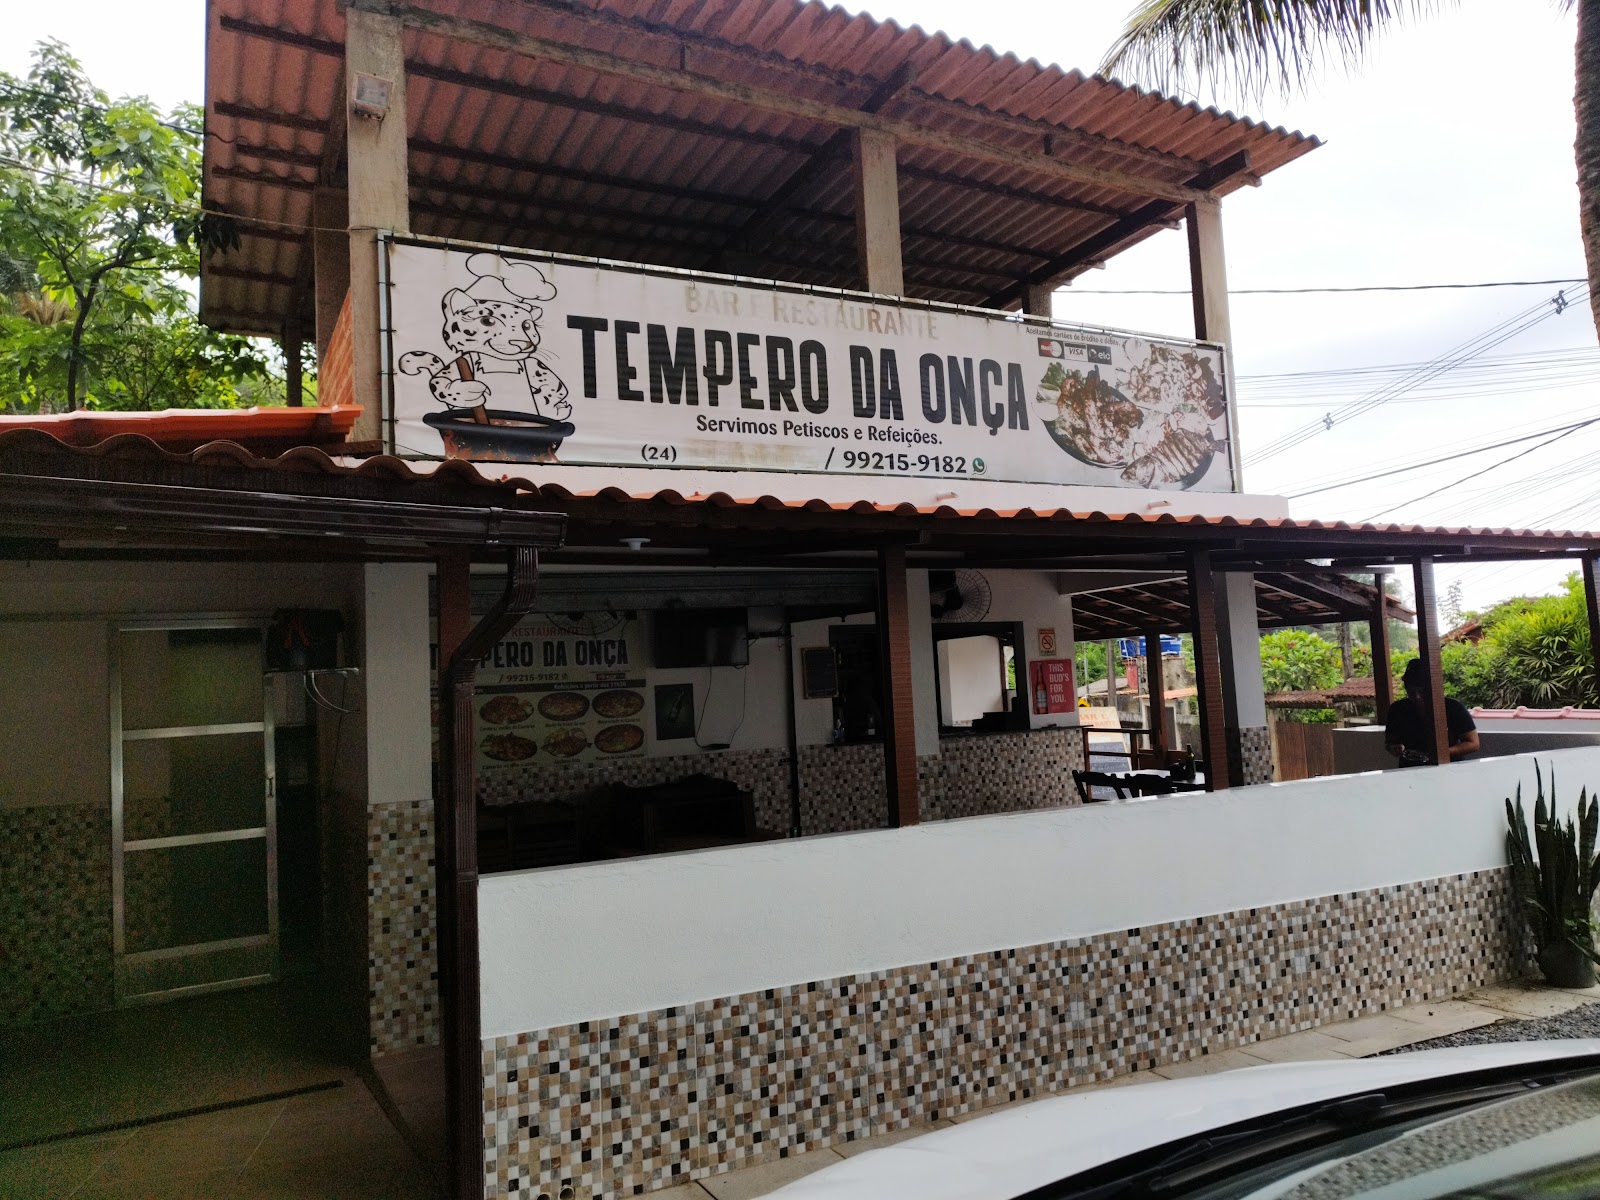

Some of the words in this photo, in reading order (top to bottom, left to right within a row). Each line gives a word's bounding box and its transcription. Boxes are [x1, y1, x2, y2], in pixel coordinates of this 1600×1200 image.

[685, 286, 739, 316] BAR
[773, 296, 939, 340] RESTAURANTE
[1026, 327, 1053, 337] Aceitamos
[1074, 333, 1080, 341] de
[1069, 348, 1084, 356] VISA
[567, 315, 830, 414] TEMPERO
[849, 345, 904, 421] DA
[919, 353, 1030, 436] ONÇA
[696, 415, 778, 435] Servimos
[783, 420, 849, 441] Petiscos
[854, 428, 863, 440] e
[868, 425, 943, 447] Refeições.
[641, 445, 677, 462] (24)
[825, 447, 835, 470] /
[843, 450, 967, 473] 99215-9182
[543, 641, 567, 667] DA
[575, 640, 628, 667] ONÇA
[1048, 664, 1064, 673] THIS
[506, 673, 559, 683] 99215-9182
[1049, 673, 1070, 682] BUD'S
[1050, 684, 1063, 692] FOR
[1051, 694, 1067, 703] YOU.
